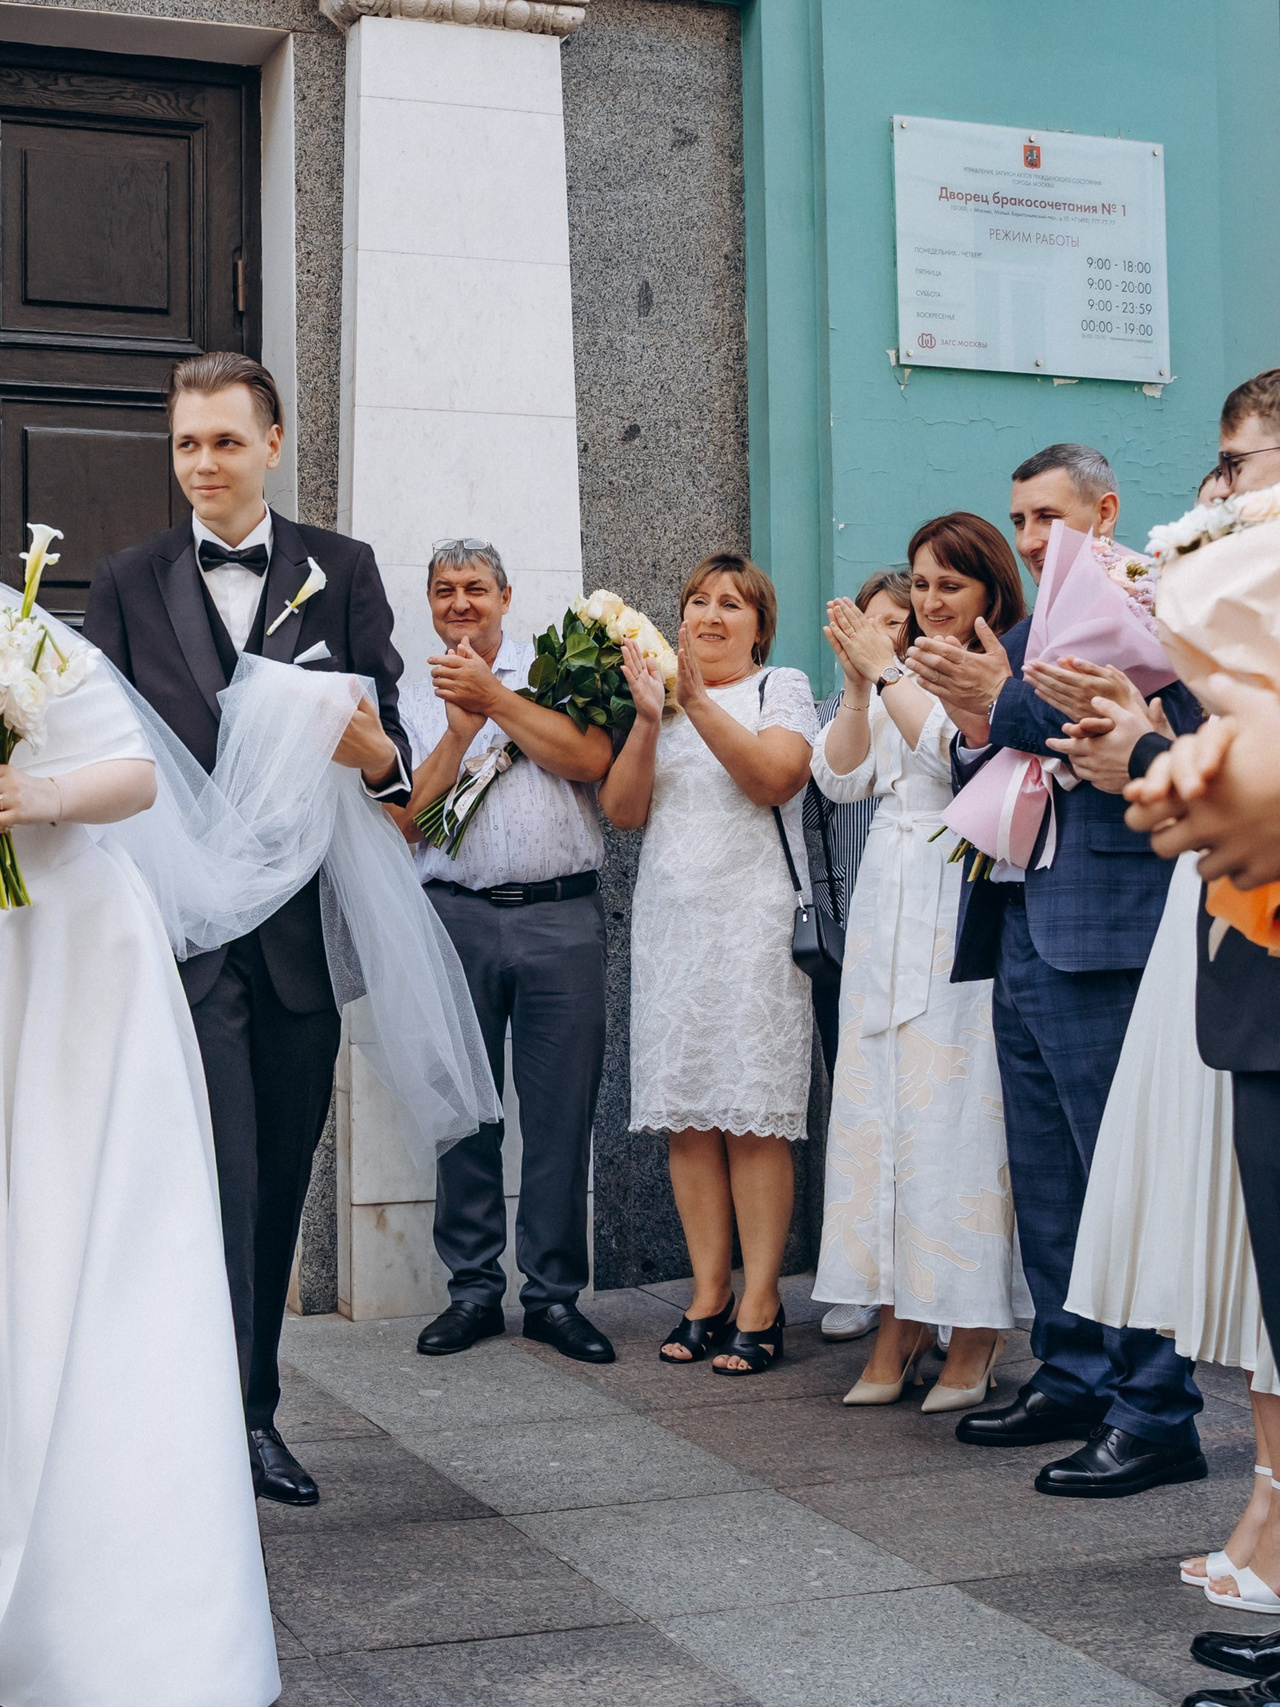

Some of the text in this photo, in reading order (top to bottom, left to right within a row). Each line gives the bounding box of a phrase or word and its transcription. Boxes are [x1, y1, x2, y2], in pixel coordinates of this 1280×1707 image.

[938, 186, 989, 205] Дворец
[992, 191, 1098, 214] бракосочетания
[1121, 205, 1126, 217] 1
[989, 228, 1079, 248] РЕЖИМ РАБОТЫ
[1086, 257, 1111, 270] 9:00
[1122, 260, 1151, 274] 18:00
[1087, 278, 1112, 291] 9:00
[1121, 280, 1152, 294] 20:00
[1087, 299, 1112, 312] 9:00
[1121, 301, 1152, 315] 23:59
[1081, 319, 1113, 333] 00:00
[1124, 322, 1153, 336] 19:00
[940, 338, 988, 349] ЗАГС МОСКВЫ
